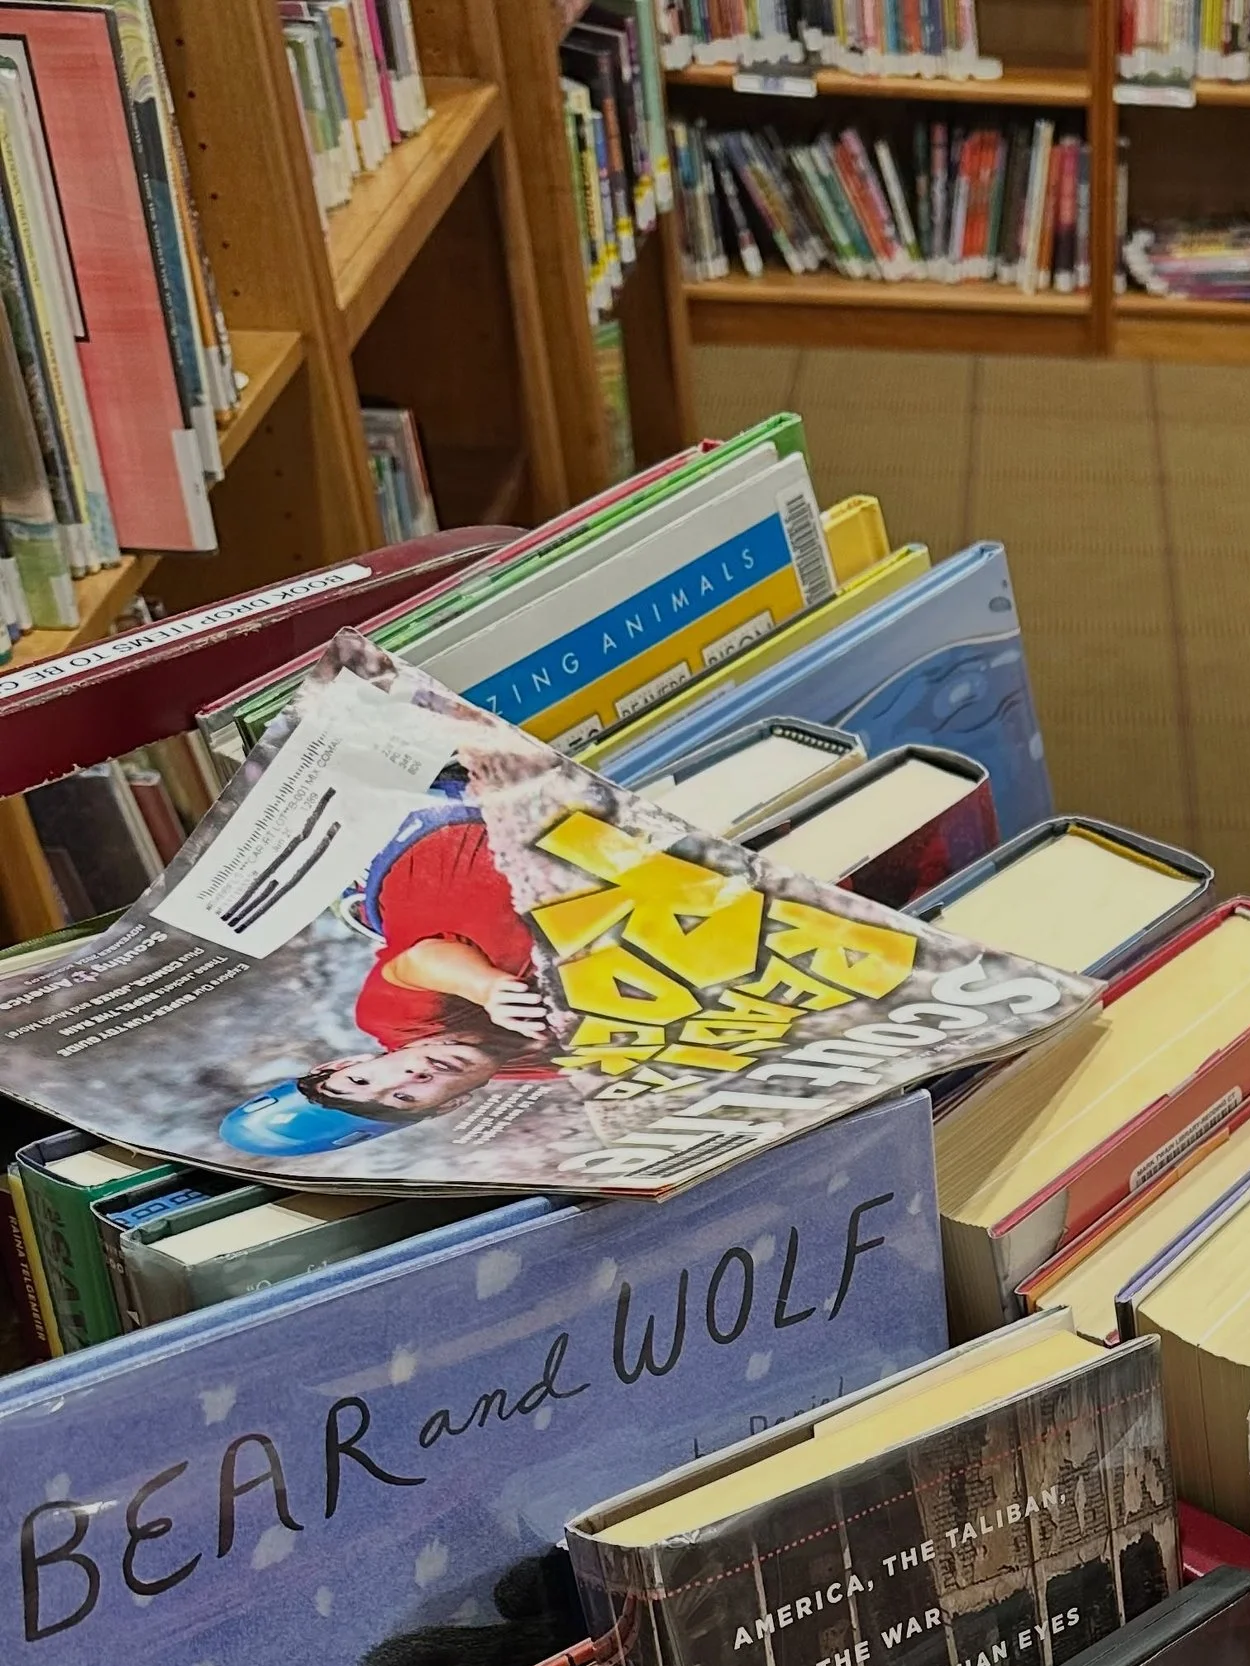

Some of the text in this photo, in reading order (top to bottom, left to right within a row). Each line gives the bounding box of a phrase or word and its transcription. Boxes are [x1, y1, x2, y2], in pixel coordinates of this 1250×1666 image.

[200, 597, 271, 625] DROP
[280, 573, 345, 602] BOOK
[69, 650, 106, 668] TO
[113, 624, 193, 654] ITEMS
[486, 652, 580, 716] ZING
[602, 546, 757, 653] ANIMALS
[23, 665, 65, 682] BE
[0, 930, 168, 1011] Scouting America
[99, 924, 146, 955] NOVEMBER
[181, 947, 205, 963] Plus
[529, 808, 764, 1076] ROCK
[56, 962, 251, 1057] Explore Our SUPER-FUN TOY GUIDE
[58, 955, 228, 1037] These Jackets REPEL THE RAIN
[91, 983, 132, 1005] JOKES
[655, 898, 918, 1073] READY
[746, 954, 1061, 1092] Scout
[596, 1063, 705, 1102] TO
[558, 1088, 837, 1182] Life
[8, 1215, 47, 1341] RAINA TELGEMEIER
[19, 1190, 895, 1644] BEAR and WOLF
[733, 1484, 1067, 1650] AMERICA, THE TALIBAN,
[880, 1607, 942, 1650] WAR
[1018, 1606, 1082, 1650] EYES
